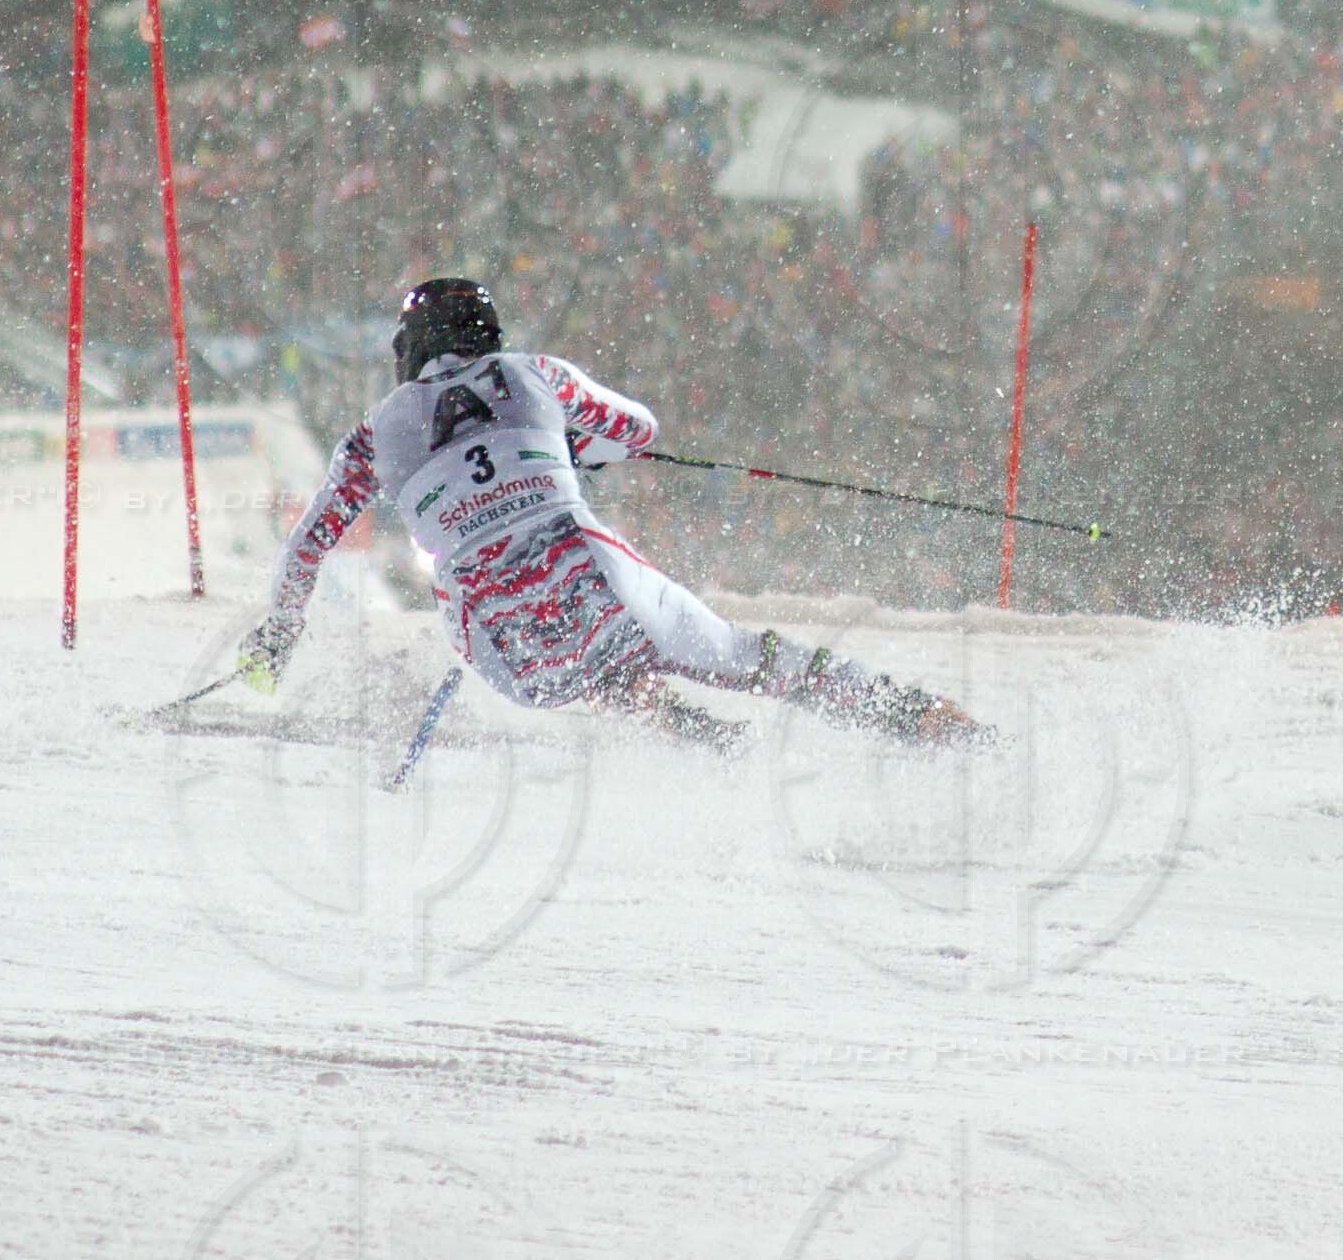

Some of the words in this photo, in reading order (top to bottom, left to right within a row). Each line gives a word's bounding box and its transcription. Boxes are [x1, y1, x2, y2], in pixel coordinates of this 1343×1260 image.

[465, 445, 495, 484] 3
[439, 475, 557, 531] Schladming
[458, 492, 546, 537] DACHSTEIN
